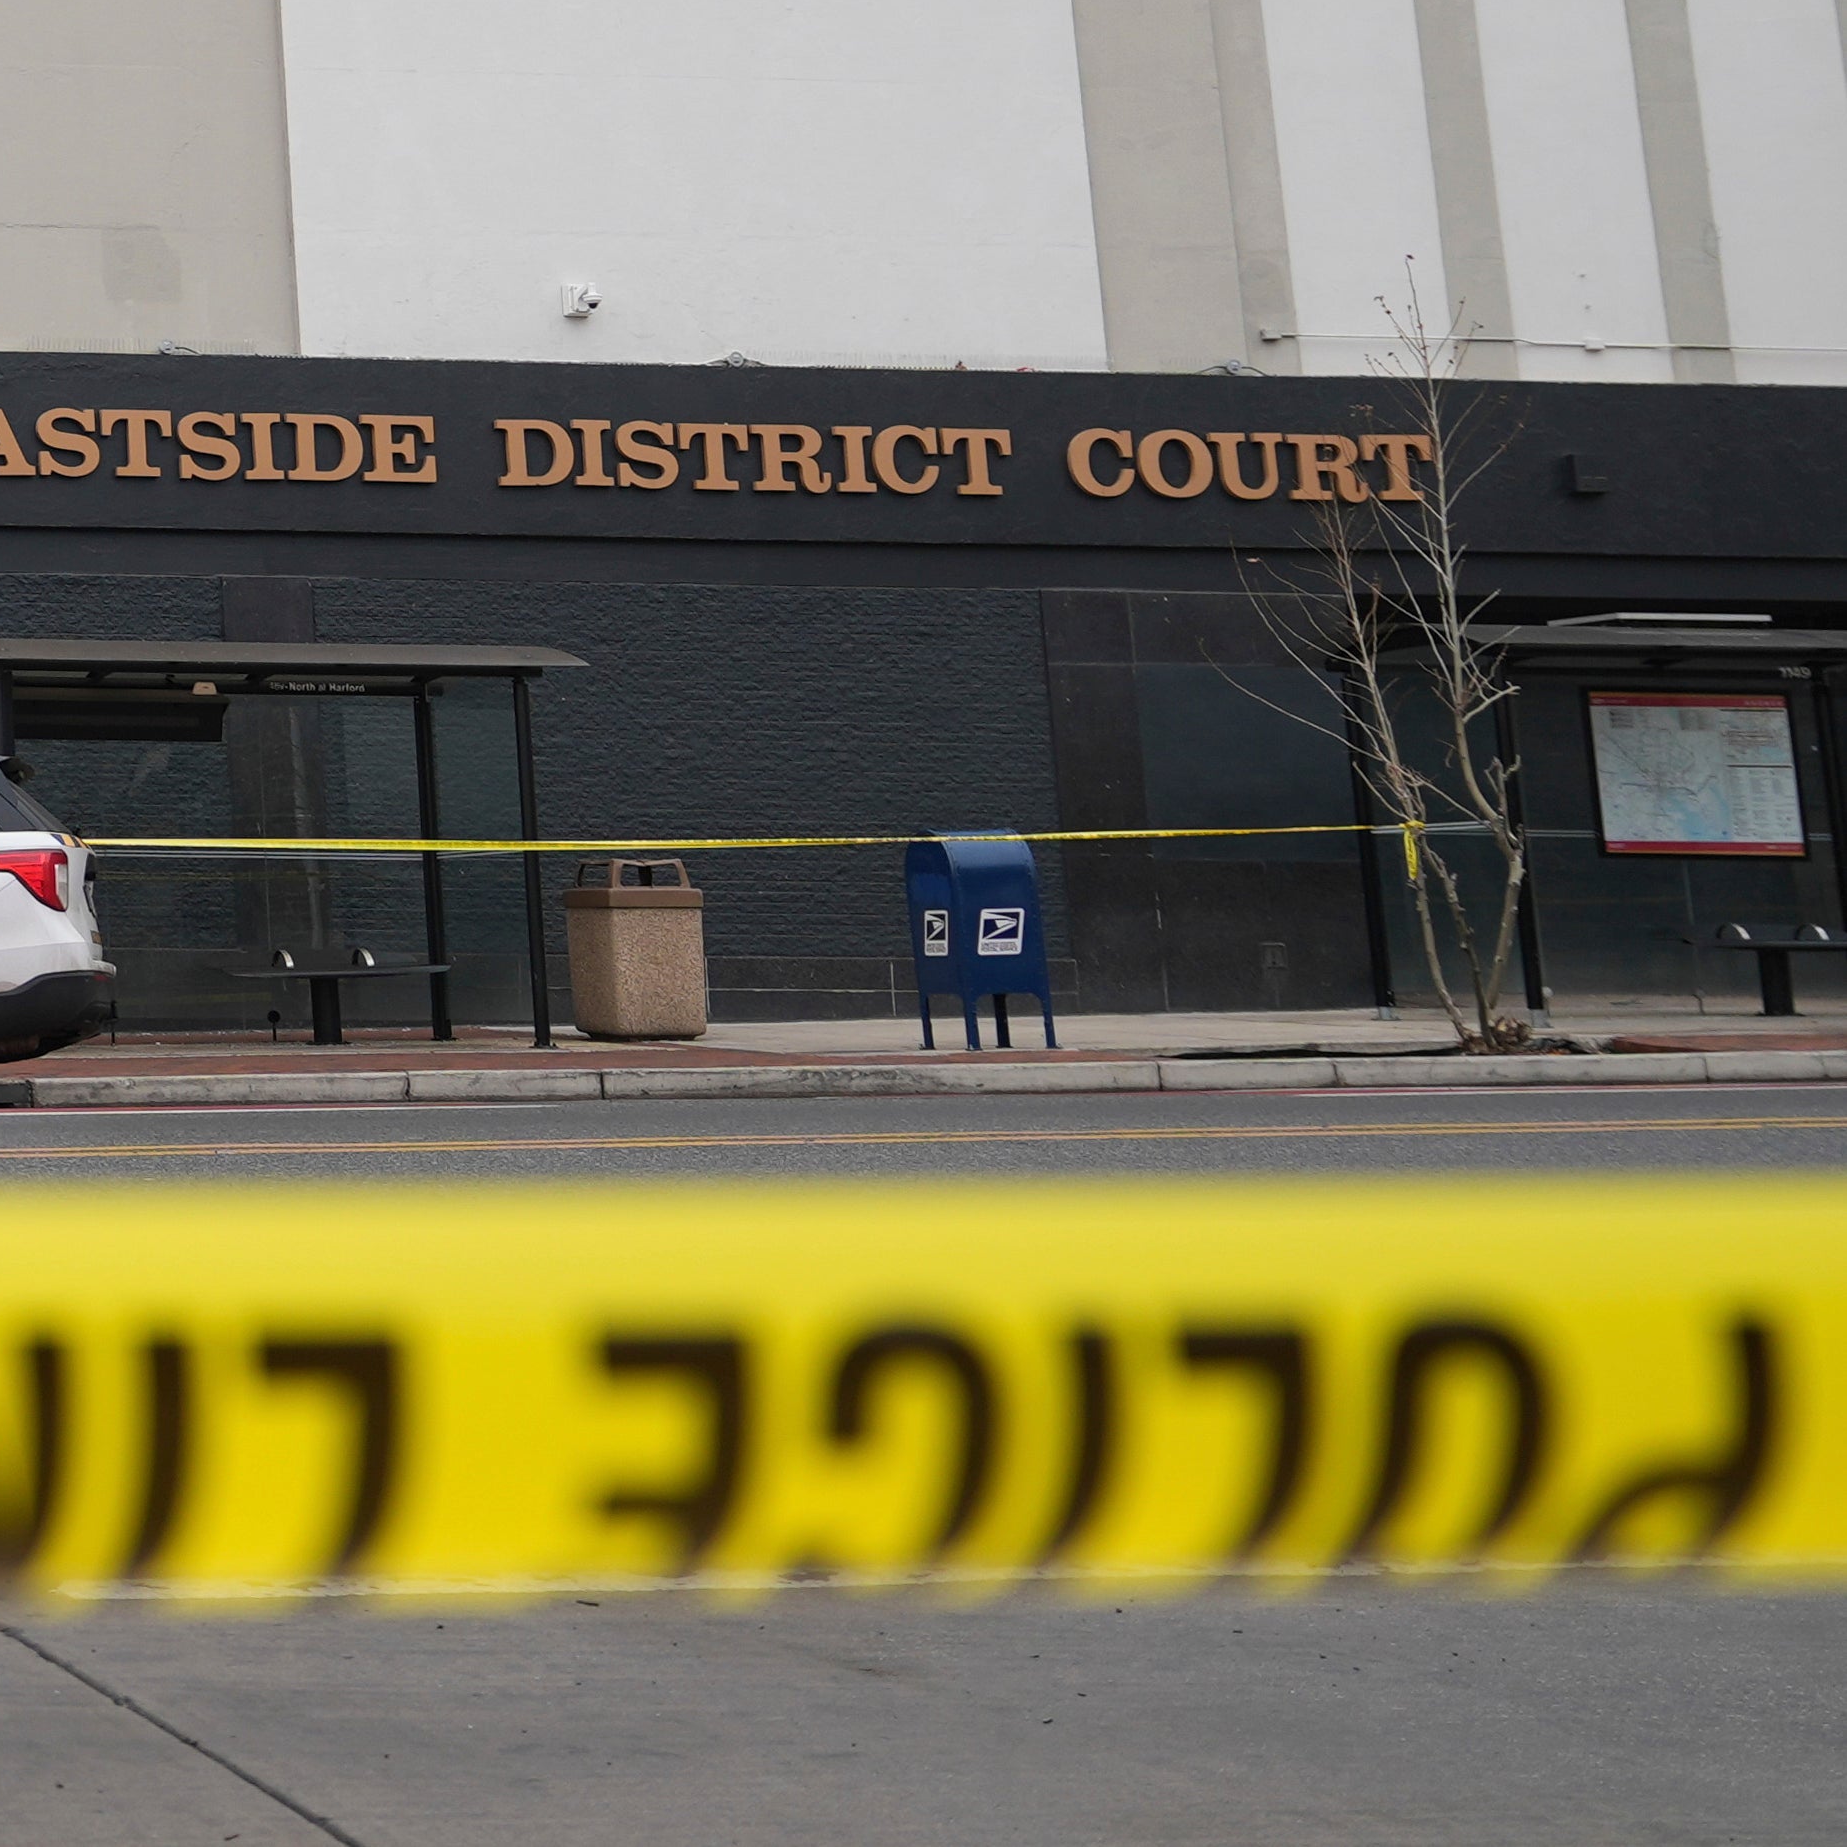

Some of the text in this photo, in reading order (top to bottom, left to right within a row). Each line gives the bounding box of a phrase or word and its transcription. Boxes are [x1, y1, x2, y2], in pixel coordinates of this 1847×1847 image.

[494, 417, 1013, 497] DISTRICT
[1064, 426, 1436, 504] COURT
[328, 682, 366, 693] Harford
[582, 1304, 1792, 1574] POLICE
